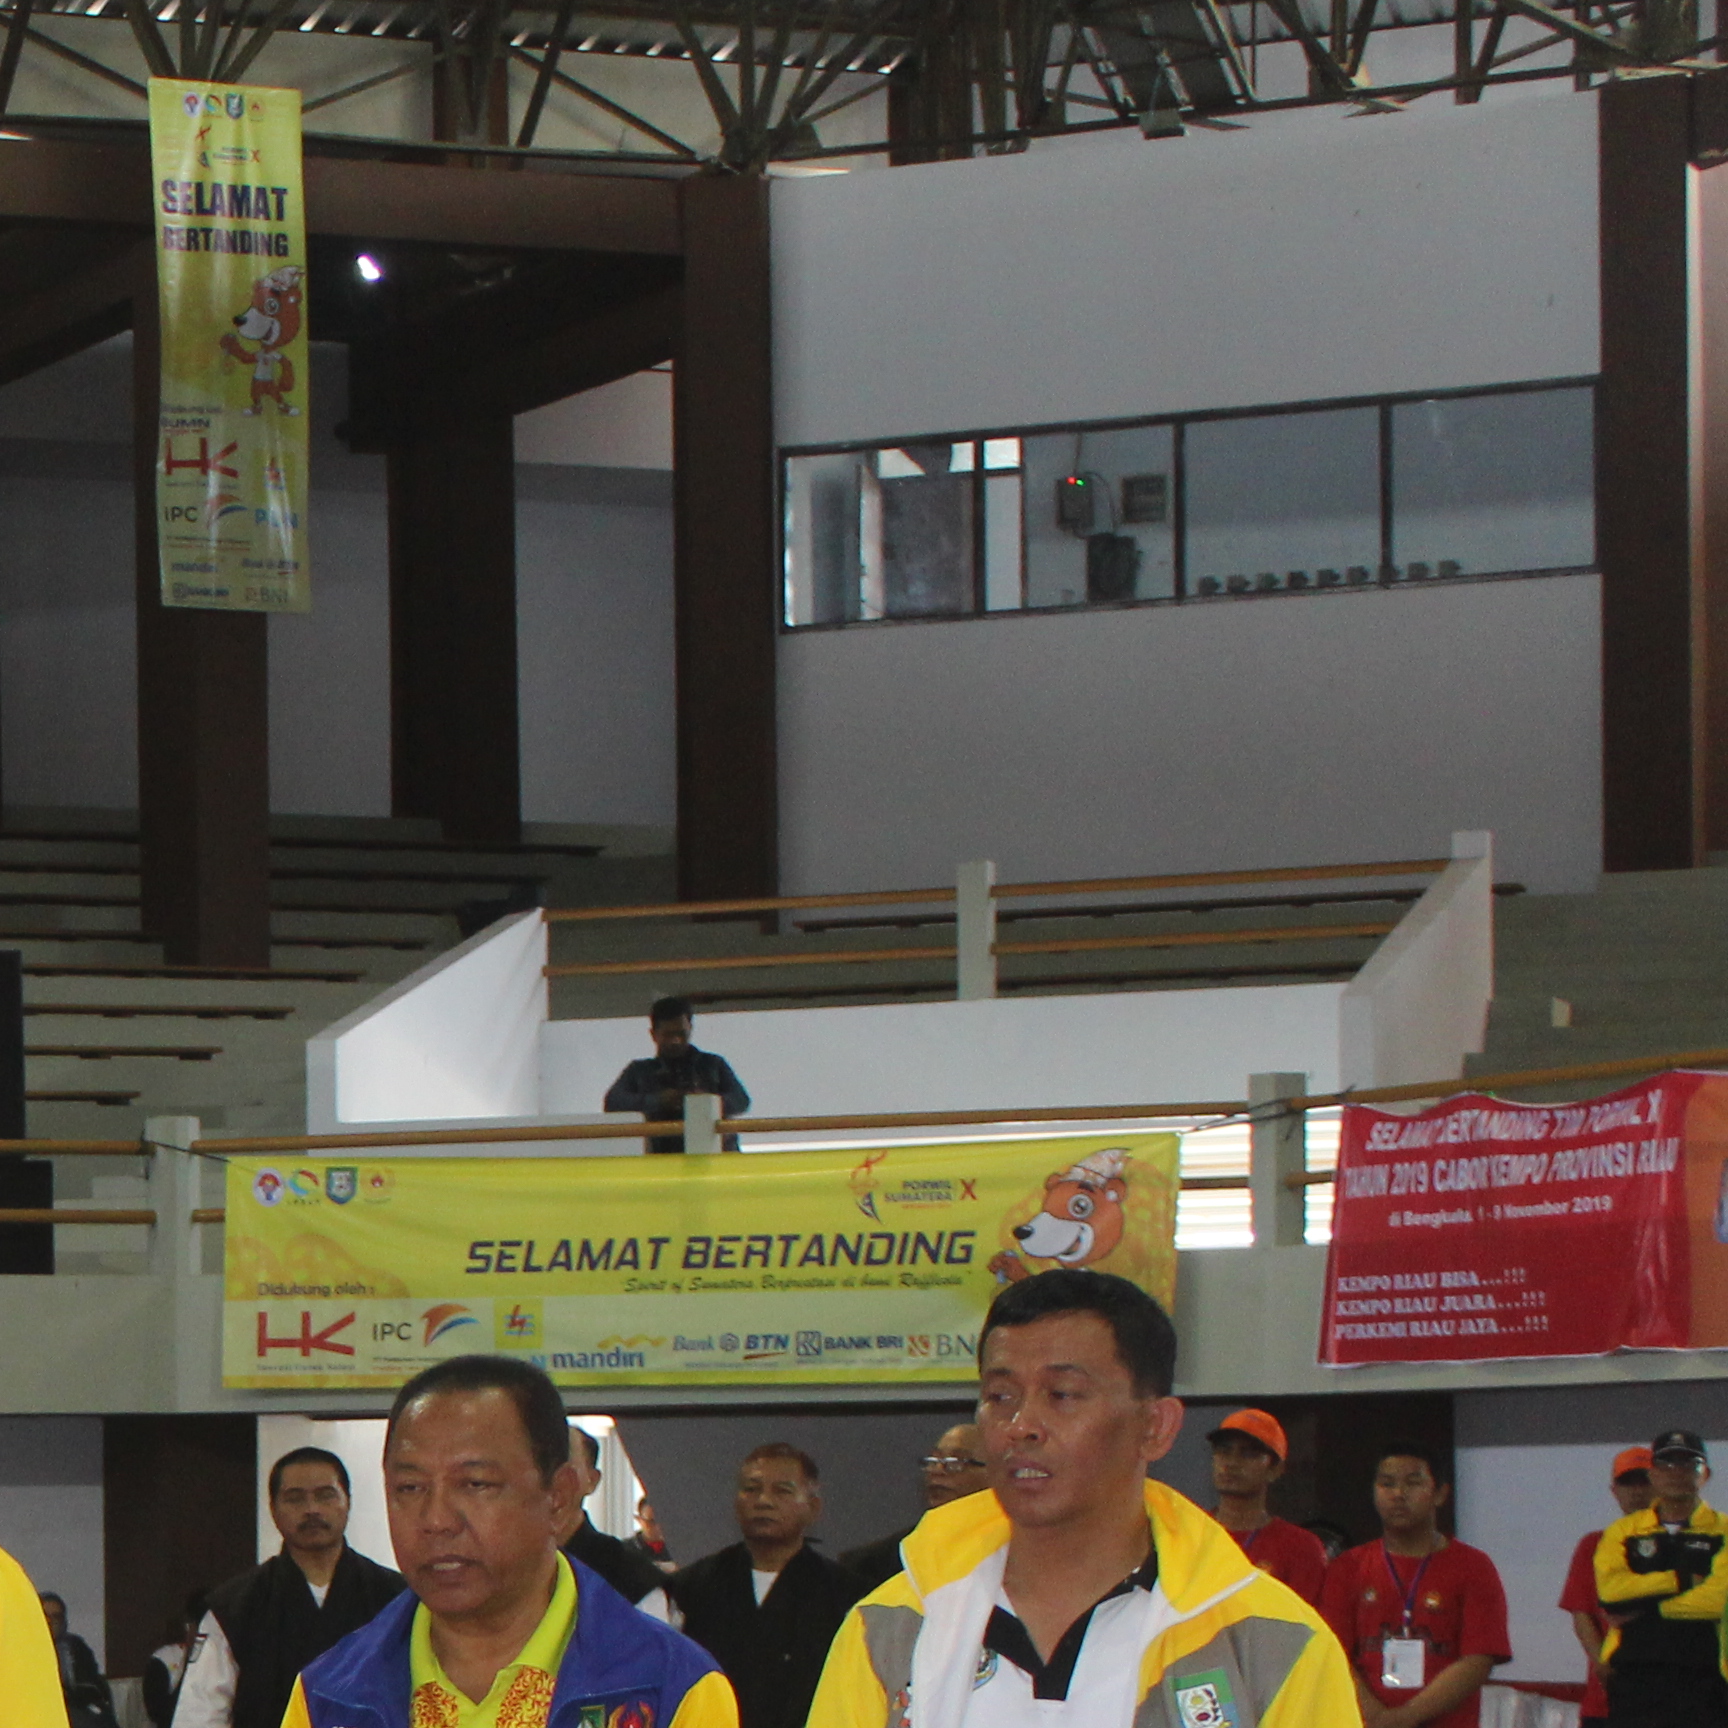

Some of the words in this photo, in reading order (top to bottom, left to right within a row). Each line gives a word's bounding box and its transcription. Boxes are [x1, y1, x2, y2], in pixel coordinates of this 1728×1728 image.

[161, 178, 289, 222] SELAMAT
[163, 224, 290, 258] BERTANDING
[165, 506, 198, 523] IPC
[959, 1178, 978, 1202] X
[1571, 1194, 1614, 1214] 2019
[465, 1237, 671, 1274] SELAMAT
[682, 1230, 977, 1269] BERTANDING
[257, 1282, 332, 1297] Didukung
[334, 1284, 367, 1296] oleh
[1393, 1272, 1438, 1291] RIAU
[257, 1310, 356, 1357] HK
[372, 1322, 412, 1341] IPC
[825, 1335, 872, 1350] BANK
[877, 1334, 905, 1349] BRI
[673, 1335, 715, 1351] Bank
[745, 1334, 790, 1350] BTN
[937, 1335, 978, 1357] BN
[553, 1345, 645, 1368] mandiri
